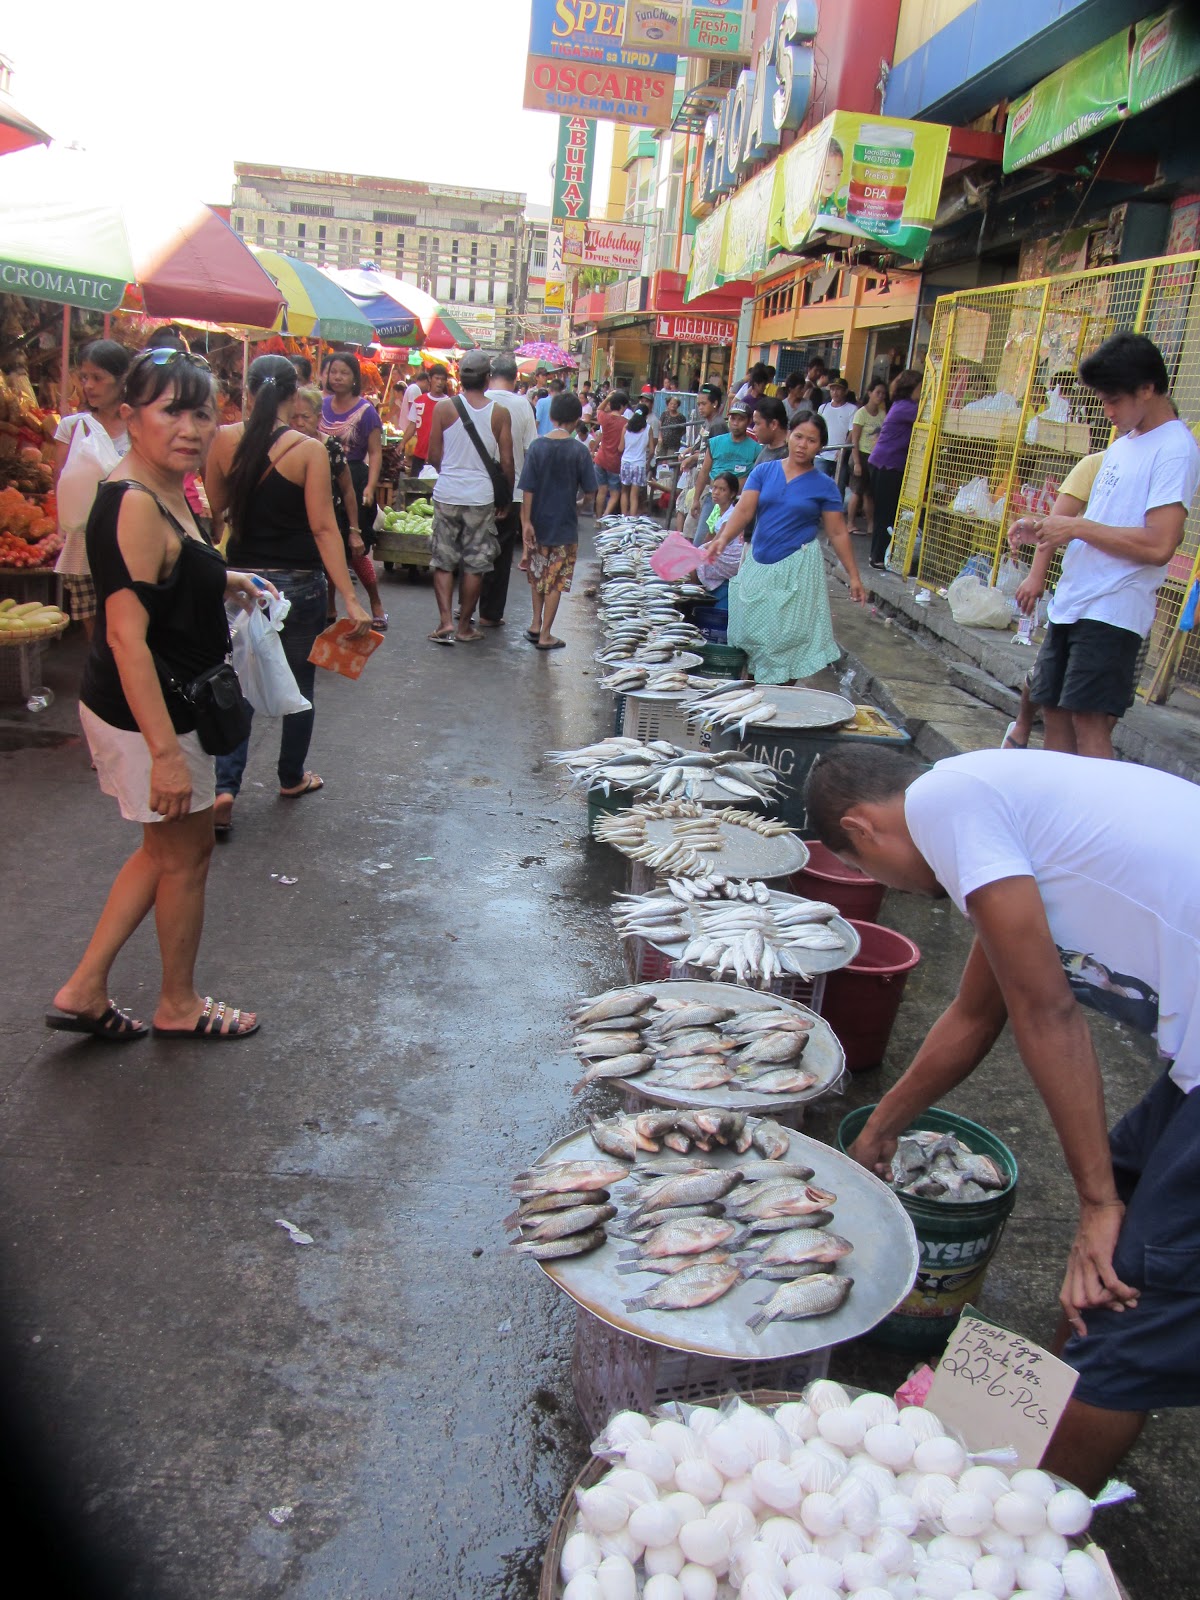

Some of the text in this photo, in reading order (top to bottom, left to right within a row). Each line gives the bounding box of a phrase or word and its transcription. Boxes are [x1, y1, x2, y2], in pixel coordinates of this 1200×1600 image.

[698, 31, 728, 46] Ripe
[551, 41, 604, 60] TIGASIN
[606, 51, 618, 62] sa
[533, 63, 665, 102] OSCAR'S
[546, 92, 649, 118] SUPERMART
[864, 187, 887, 200] DHA
[584, 229, 642, 258] Mabuhay
[584, 251, 610, 264] Drug
[612, 254, 638, 266] Store
[0, 263, 112, 301] CROMATIC
